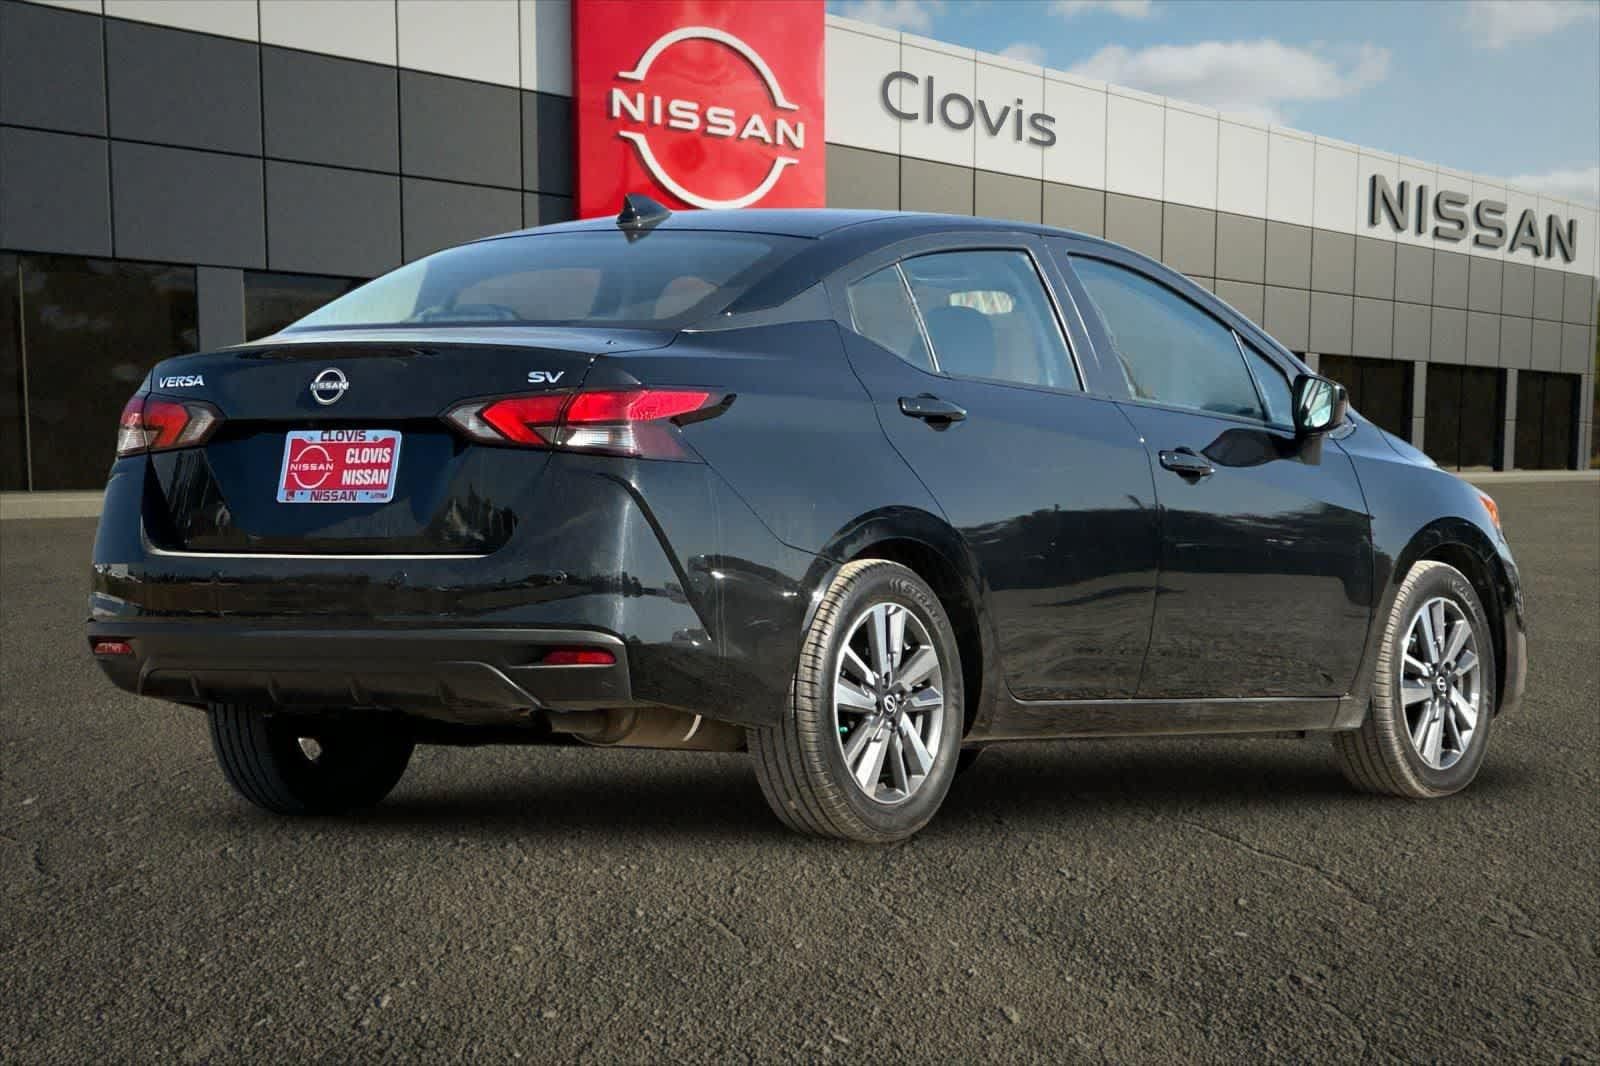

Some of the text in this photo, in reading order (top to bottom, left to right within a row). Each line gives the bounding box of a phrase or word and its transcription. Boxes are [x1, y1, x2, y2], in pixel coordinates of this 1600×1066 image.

[881, 70, 1057, 147] Clovis
[610, 87, 806, 149] NISSAN
[1368, 173, 1578, 264] NISSAN
[159, 375, 205, 389] VERSA
[527, 370, 565, 383] SV
[310, 381, 349, 391] NISSAN
[320, 430, 366, 442] CLOVIS
[345, 447, 392, 464] CLOVIS
[290, 463, 334, 471] NISSAN
[342, 468, 389, 485] NISSAN
[310, 491, 358, 501] NISSAN
